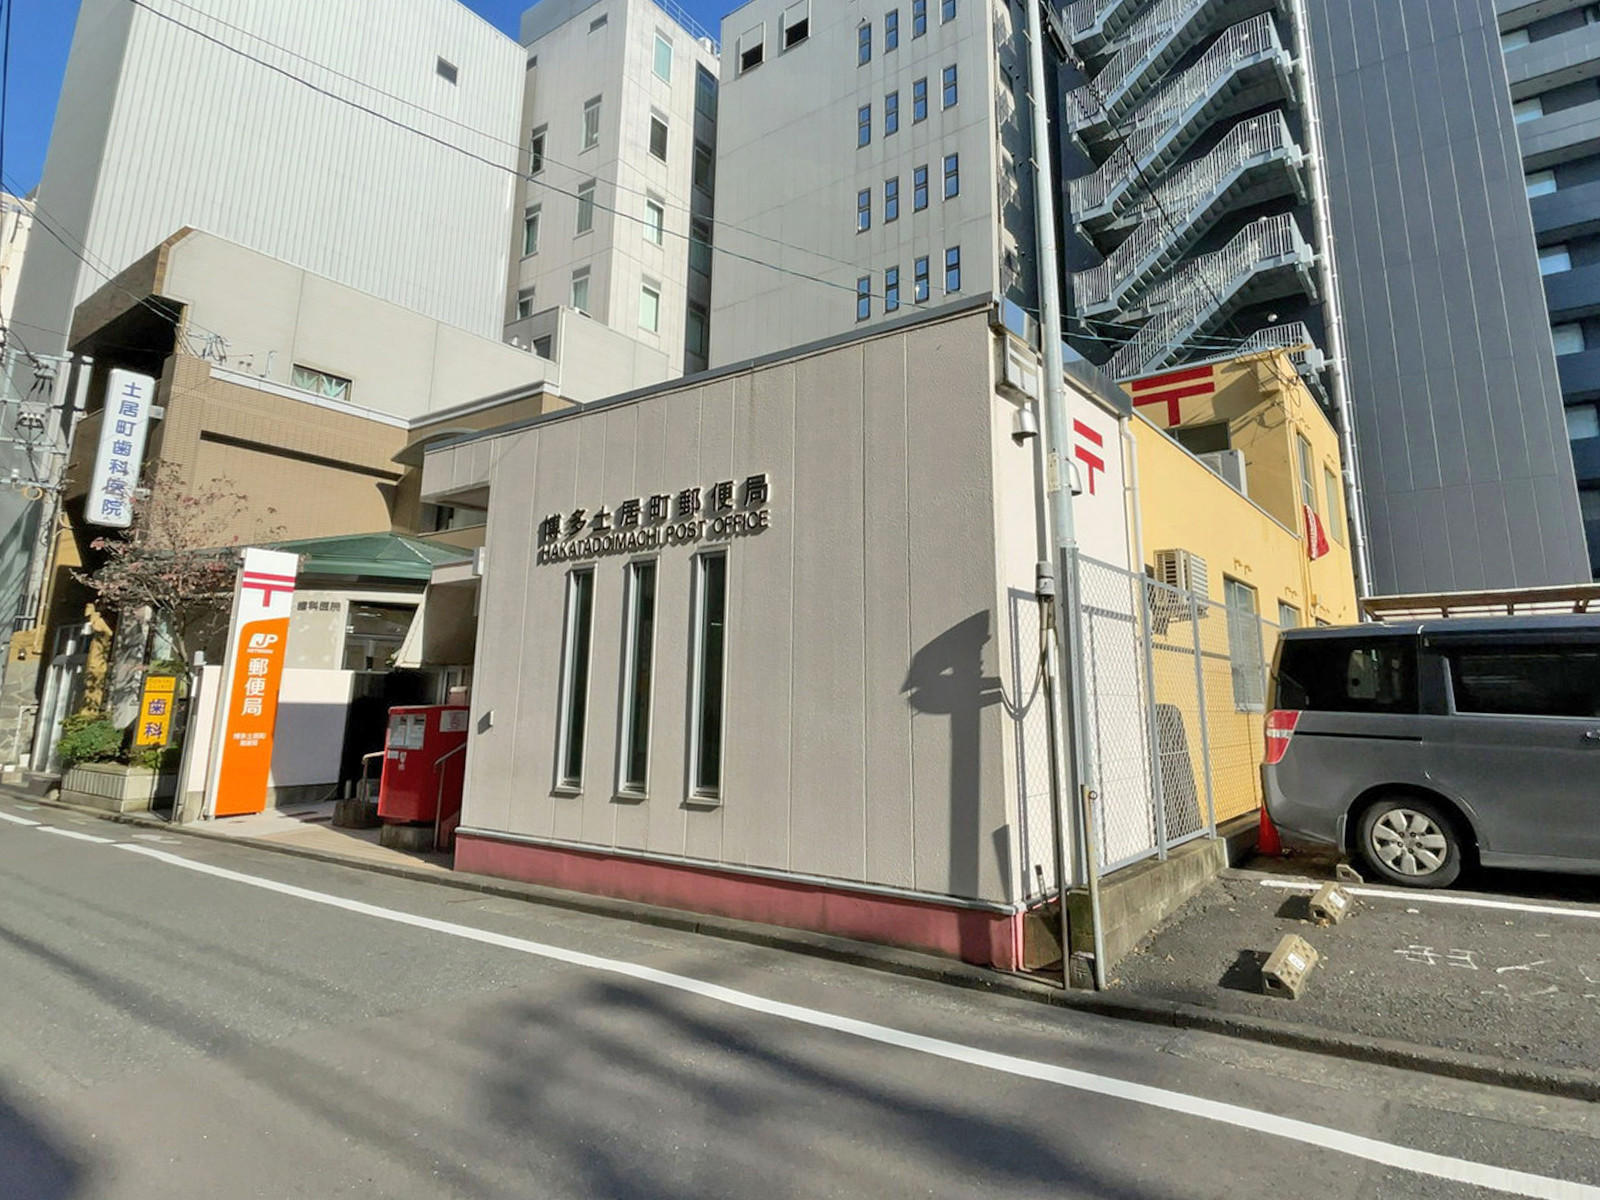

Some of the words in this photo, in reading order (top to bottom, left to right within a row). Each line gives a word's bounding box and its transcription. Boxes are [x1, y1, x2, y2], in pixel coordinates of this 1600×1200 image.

[101, 381, 142, 517] 土居町歯科医院
[540, 526, 661, 562] HAKATADOIMACHI
[666, 519, 706, 540] POST
[713, 509, 769, 534] OFFICE
[543, 473, 768, 541] 博多土居町郵便局
[241, 657, 270, 717] 郵便局
[143, 698, 167, 739] 歯科
